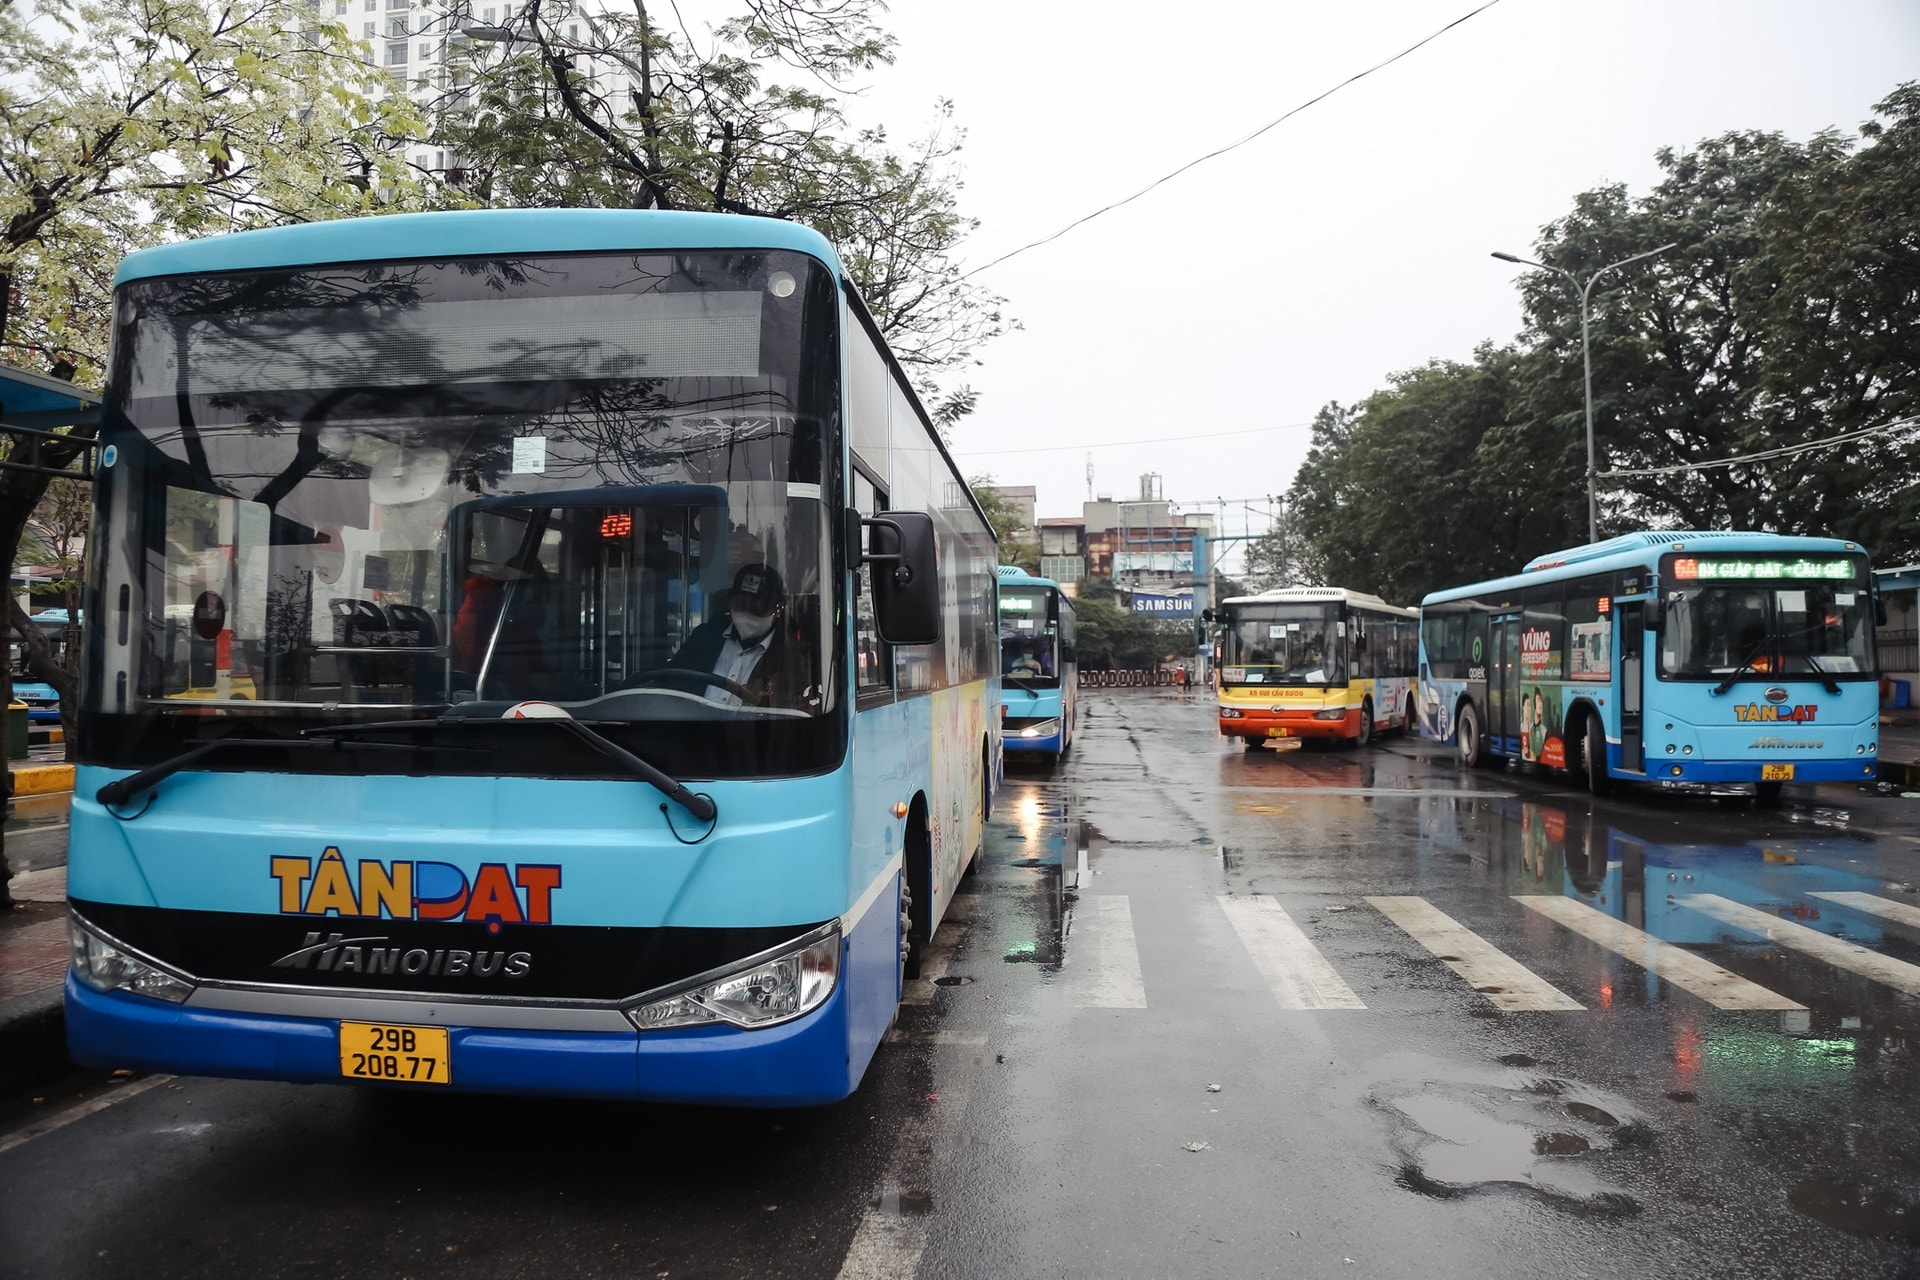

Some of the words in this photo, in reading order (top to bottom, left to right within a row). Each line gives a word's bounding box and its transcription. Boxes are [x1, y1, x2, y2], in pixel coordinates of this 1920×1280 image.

[1136, 599, 1193, 612] SAMSUN
[1522, 627, 1550, 651] VÙNG
[1521, 651, 1550, 665] FREESHIP
[369, 1027, 417, 1053] 29B
[351, 1052, 437, 1080] 208.77
